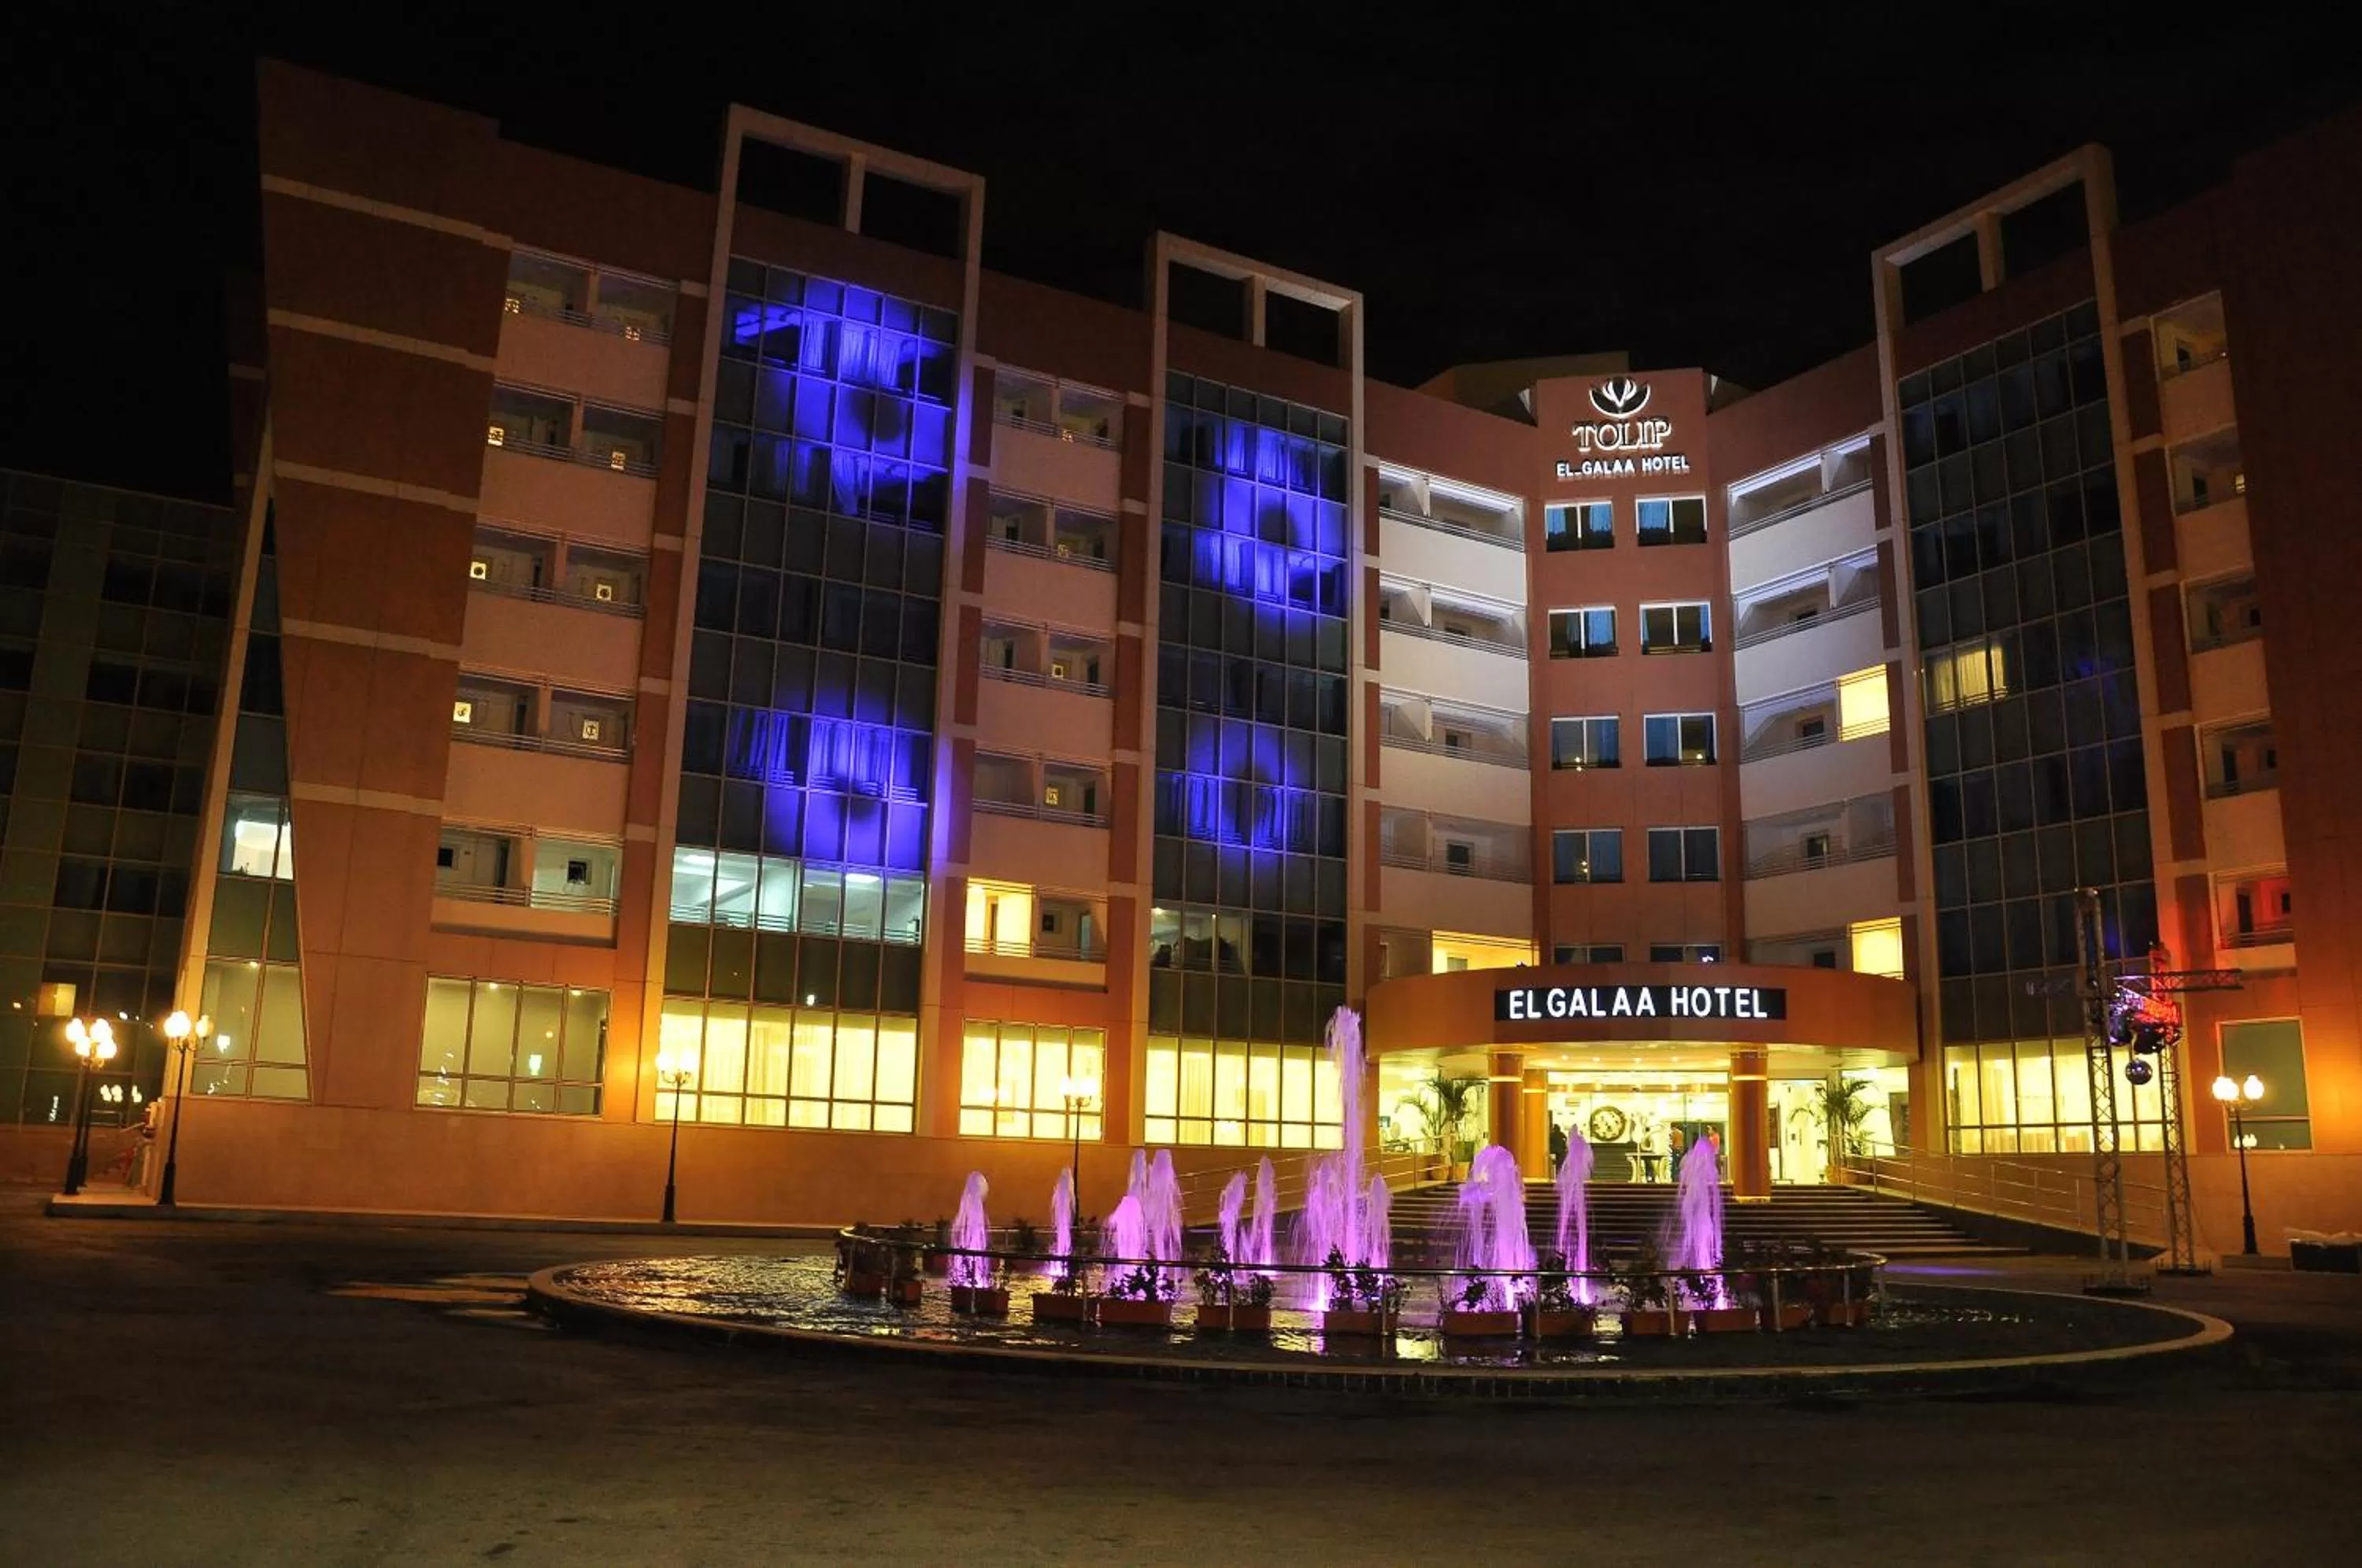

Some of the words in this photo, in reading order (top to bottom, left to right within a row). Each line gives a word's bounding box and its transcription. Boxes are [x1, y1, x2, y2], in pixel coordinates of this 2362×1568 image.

[1572, 420, 1672, 452] TOLIP
[1642, 456, 1690, 473] HOTEL
[1671, 986, 1768, 1019] HOTEL
